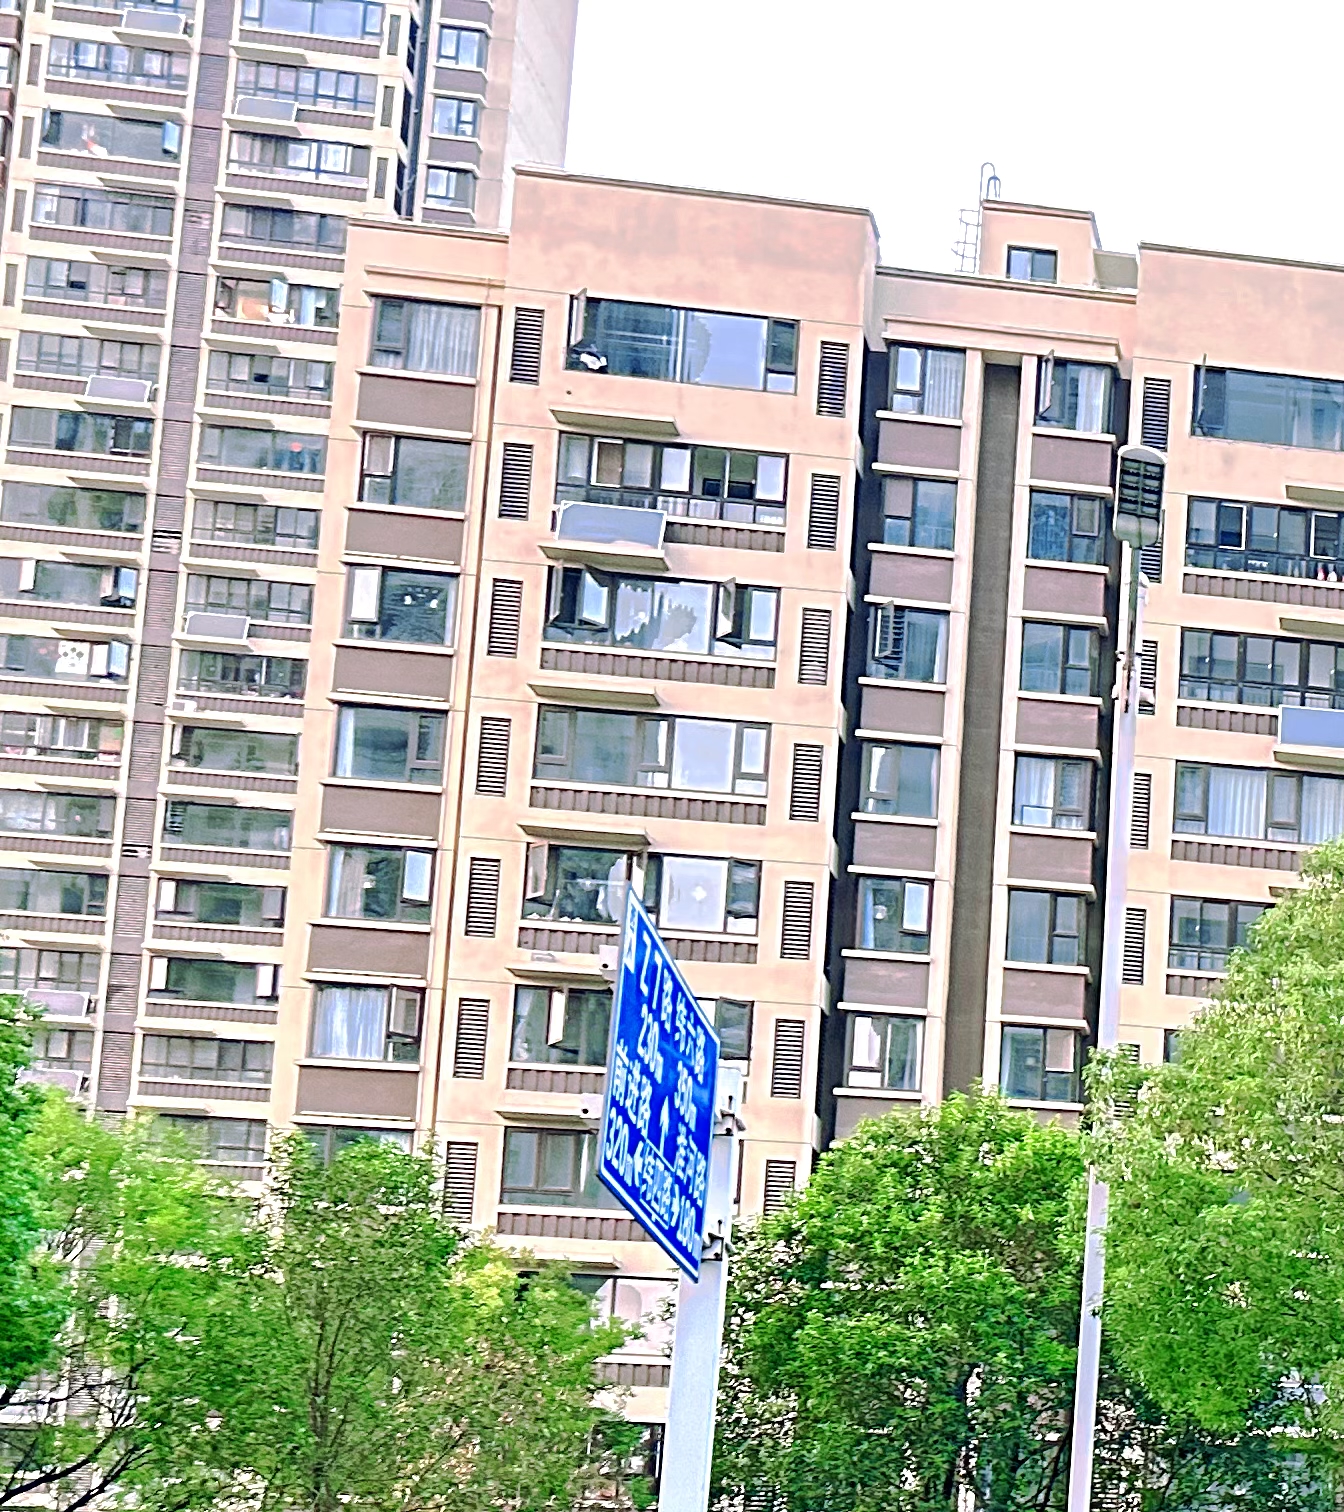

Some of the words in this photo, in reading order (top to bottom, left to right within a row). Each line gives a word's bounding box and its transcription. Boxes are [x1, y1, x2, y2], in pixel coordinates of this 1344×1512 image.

[637, 1004, 663, 1083] 230m
[612, 1038, 653, 1139] 前进路
[605, 1107, 634, 1186] 320m
